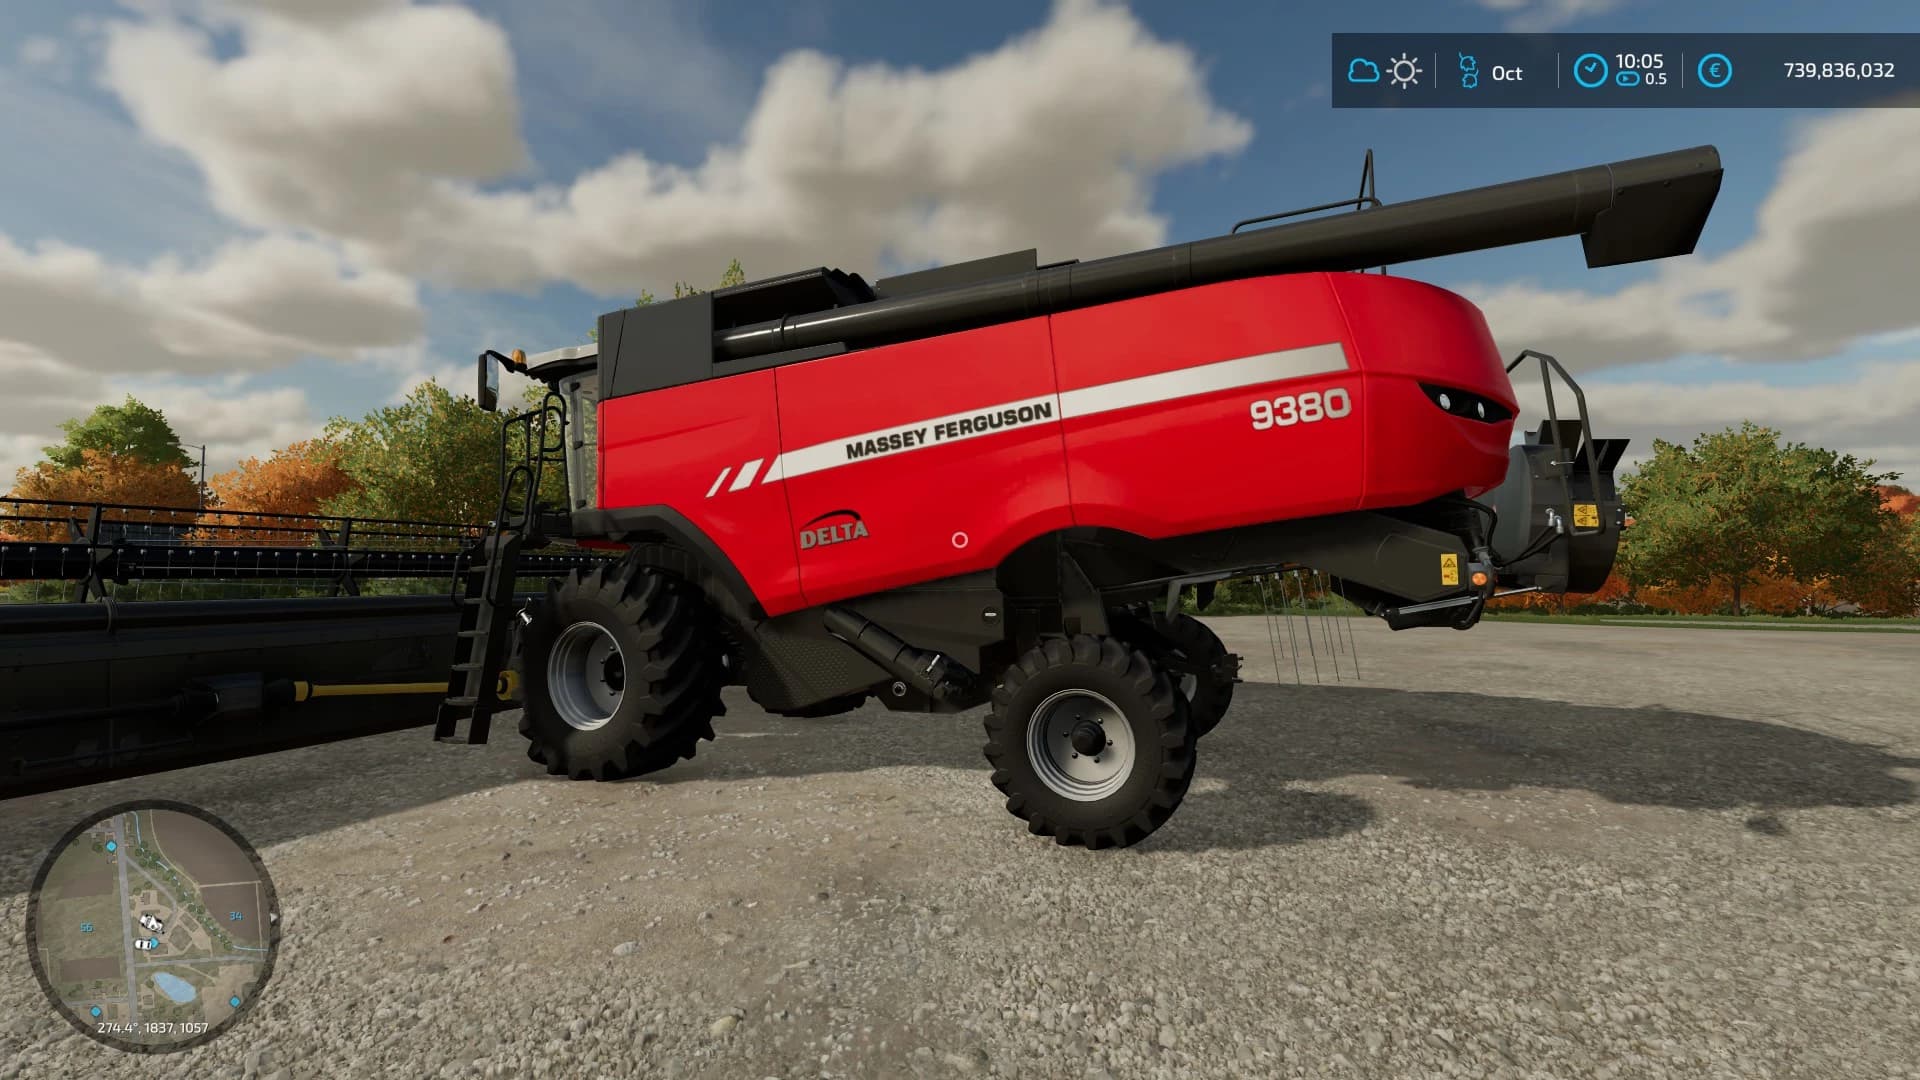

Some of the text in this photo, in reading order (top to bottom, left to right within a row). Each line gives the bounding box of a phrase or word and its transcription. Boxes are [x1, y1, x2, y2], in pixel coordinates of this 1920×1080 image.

[846, 402, 1052, 459] MASSEY FERGUSON
[1250, 387, 1352, 431] 9380
[800, 520, 869, 549] DELTA
